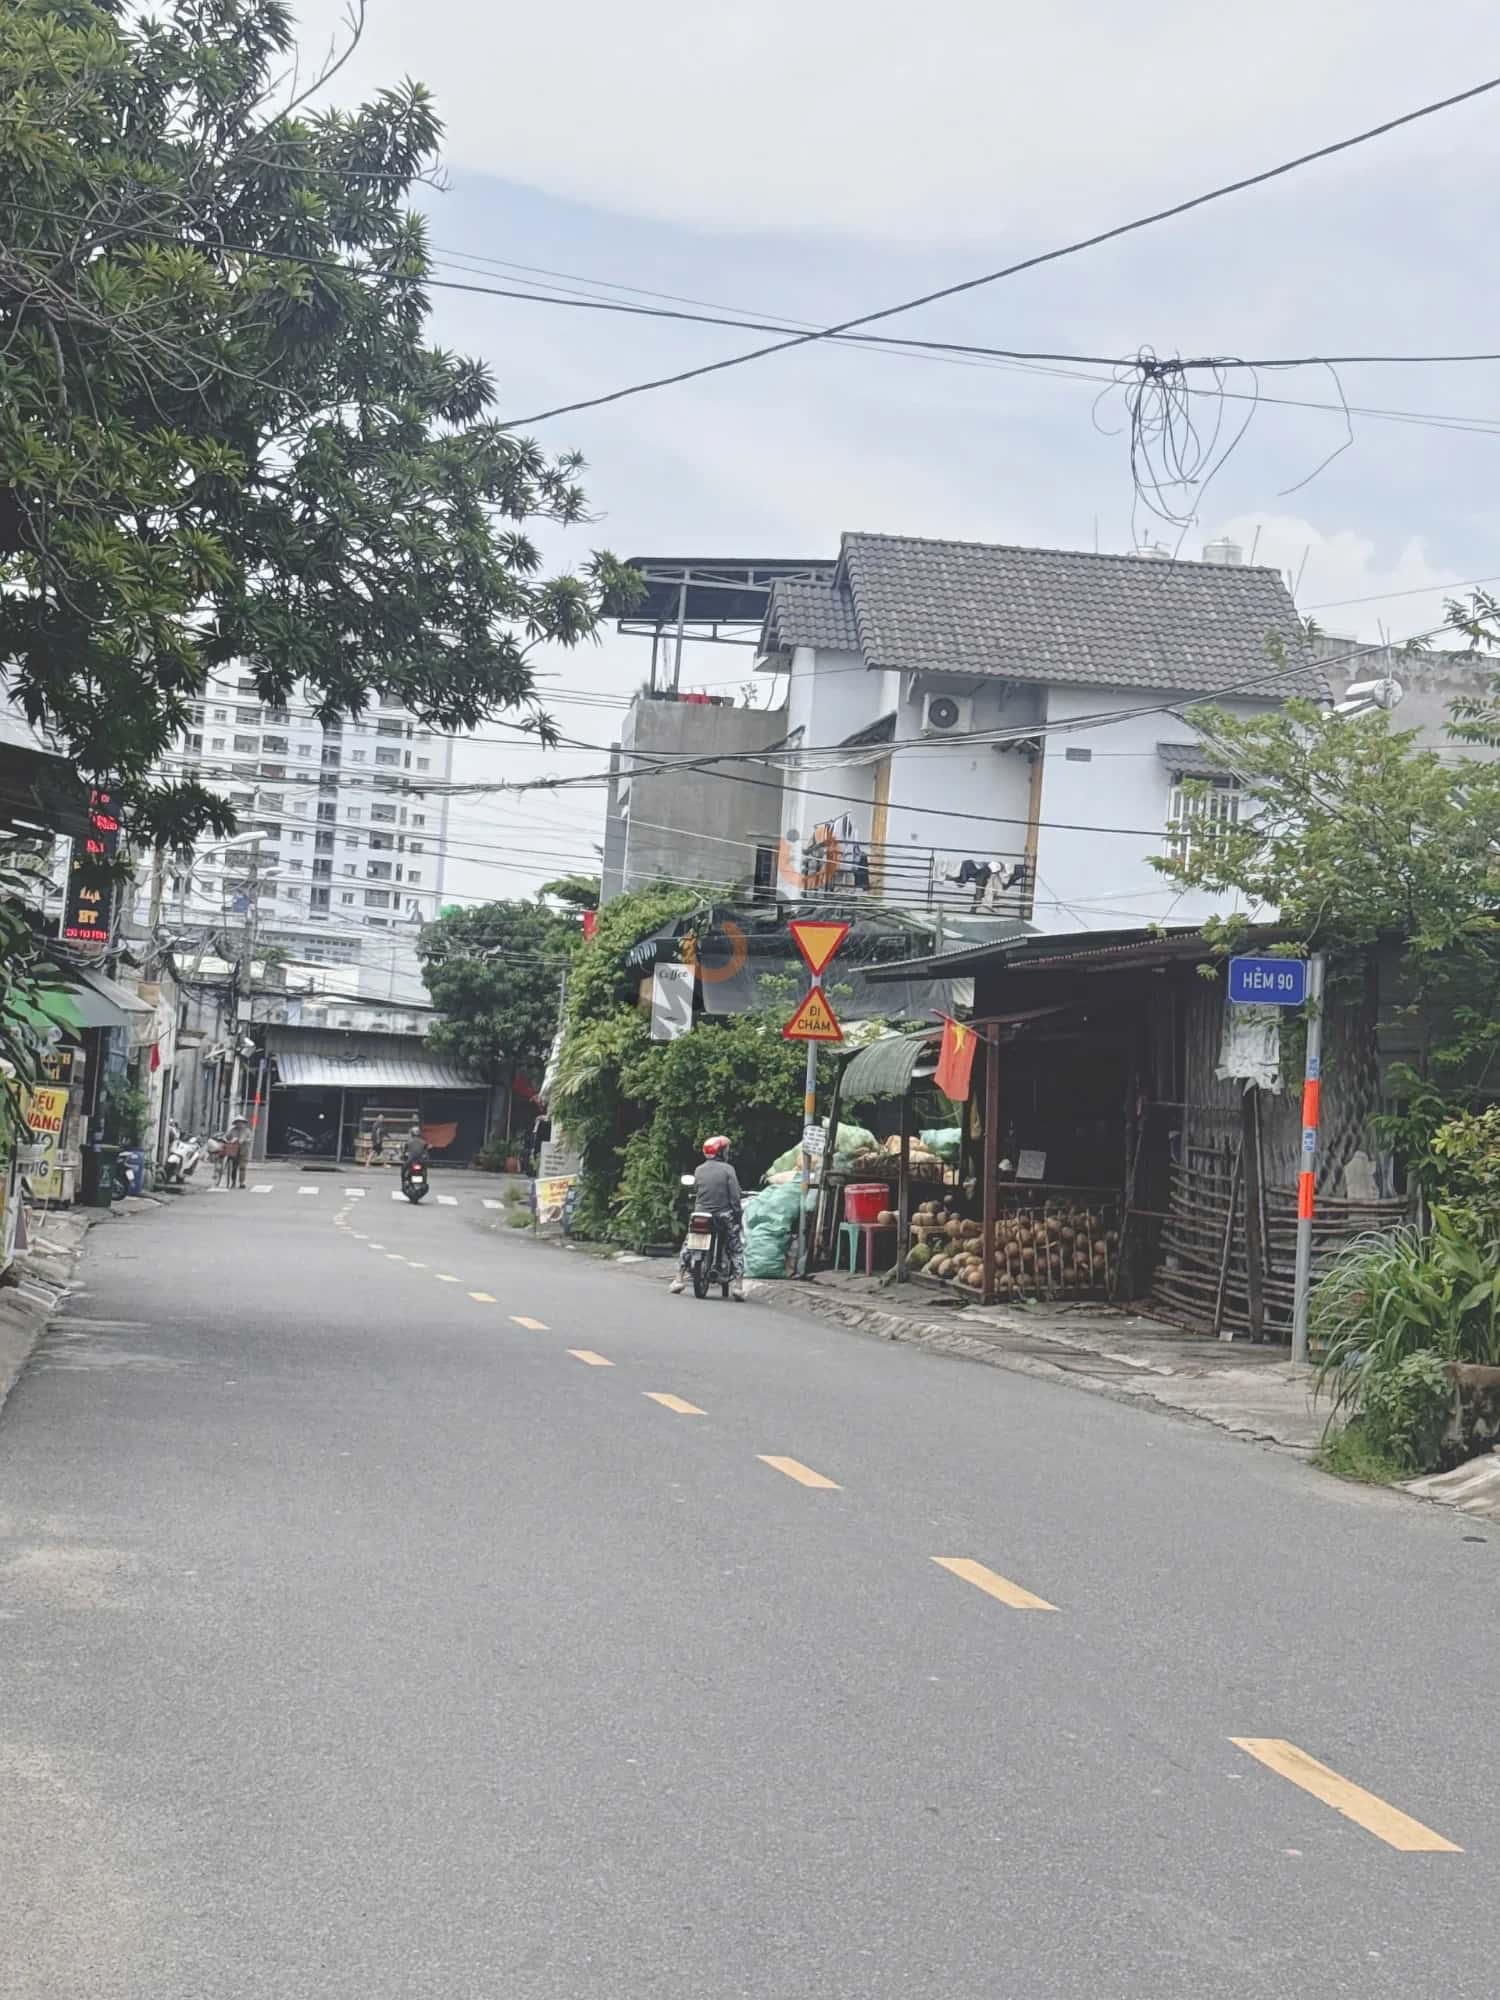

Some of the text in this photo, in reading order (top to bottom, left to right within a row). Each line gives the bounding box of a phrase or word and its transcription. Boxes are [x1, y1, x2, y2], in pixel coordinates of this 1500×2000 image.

[1243, 966, 1293, 990] HẺM 90
[809, 1006, 821, 1017] ĐI
